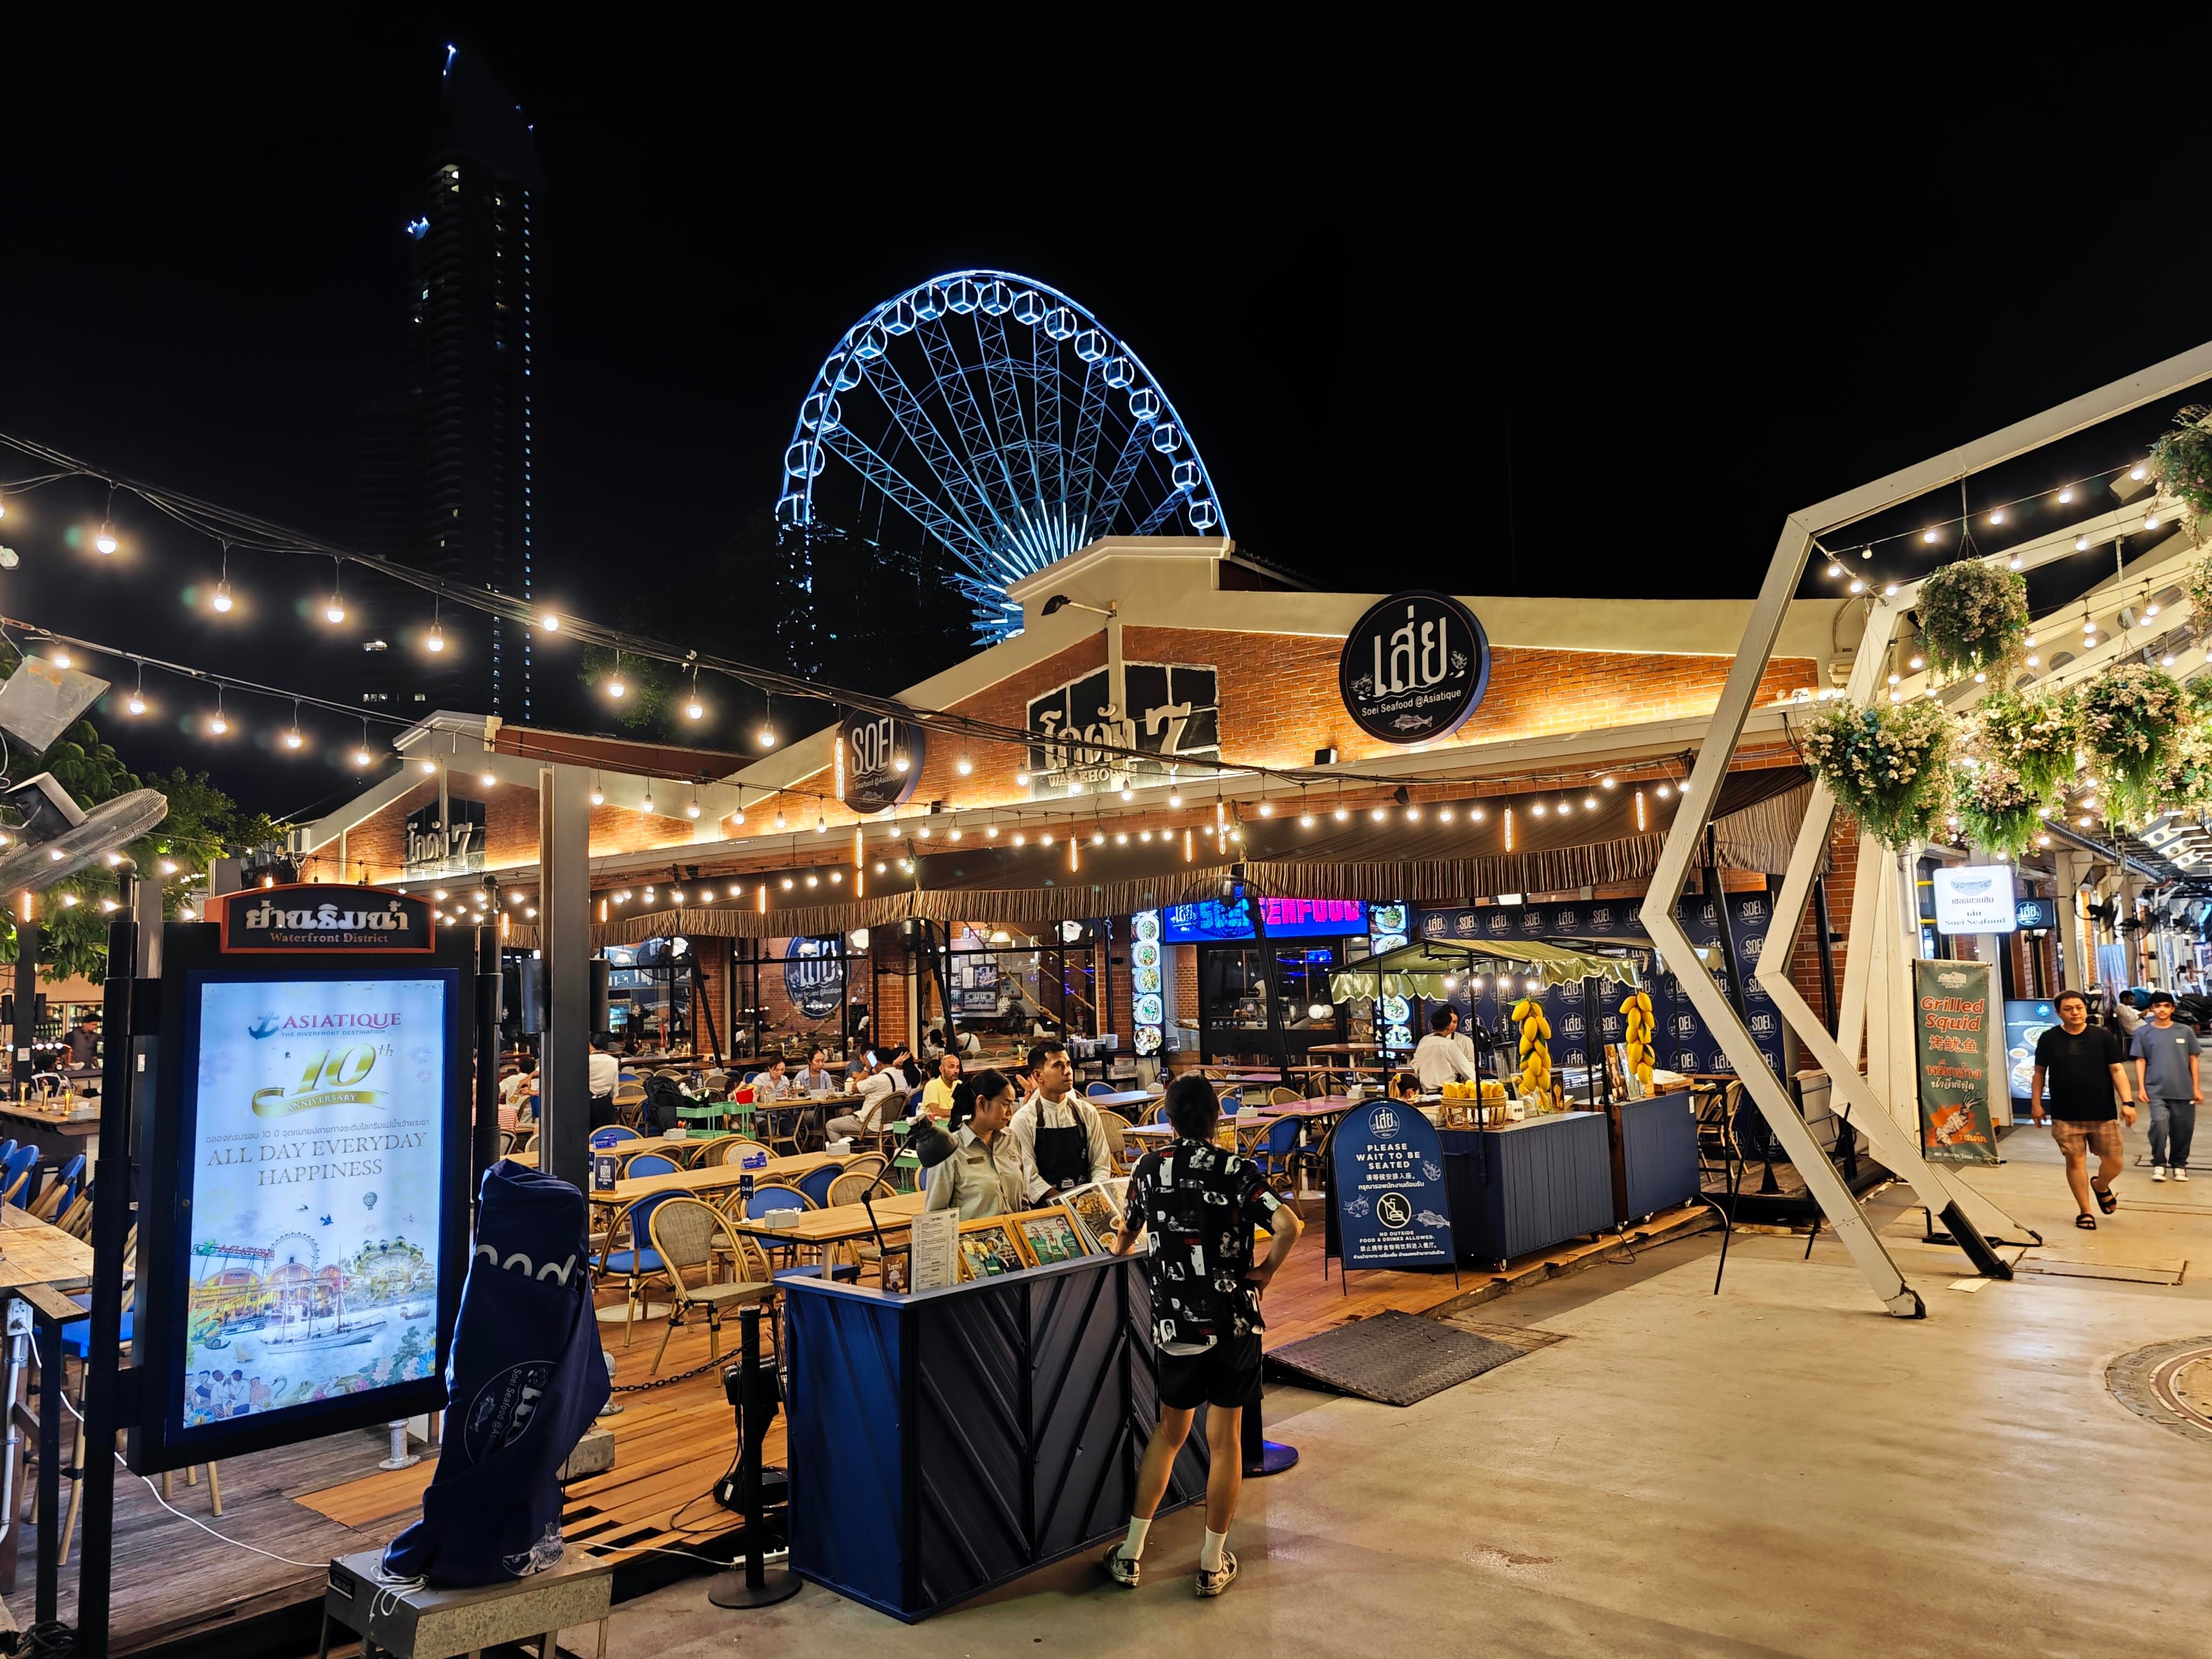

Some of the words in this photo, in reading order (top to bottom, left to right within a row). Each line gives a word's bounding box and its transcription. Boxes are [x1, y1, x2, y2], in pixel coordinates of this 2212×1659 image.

[1374, 605, 1447, 696] เส่ย
[1361, 705, 1379, 717] Soei
[1381, 698, 1413, 712] Seafood
[1415, 689, 1461, 707] @Asiatique
[1146, 702, 1191, 770] 7
[852, 717, 894, 775] SOEI
[855, 779, 873, 789] Seafood
[451, 822, 473, 866] 7
[1593, 908, 1610, 924] SOEI
[1743, 900, 1761, 916] SOEI
[2020, 903, 2036, 916] เส่ย
[1428, 915, 1442, 932] เส่ย
[1460, 915, 1474, 929] SOEI
[1525, 912, 1540, 926] SOEI
[270, 932, 340, 943] Waterfront
[344, 933, 388, 943] District
[1920, 996, 1985, 1014] Grilled
[282, 1013, 401, 1029] ASIATIQUE
[1565, 1014, 1581, 1031] เส่ย
[1751, 1015, 1770, 1030] SOEI
[1925, 1013, 1981, 1033] Squid
[1928, 1035, 1978, 1053] 烤鱿鱼
[287, 1094, 356, 1111] ANNIVERSARY
[1375, 1109, 1393, 1129] เส่ย
[274, 1129, 280, 1137] ปี
[207, 1147, 252, 1166] ALL
[259, 1142, 308, 1163] DAY
[312, 1132, 427, 1157] EVERYDAY
[1367, 1143, 1408, 1152] PLEASE
[1356, 1153, 1384, 1161] WAIT
[1368, 1161, 1410, 1170] SEATED
[258, 1159, 382, 1185] HAPPINESS
[510, 1368, 522, 1387] Soei
[497, 1387, 515, 1420] Seafood
